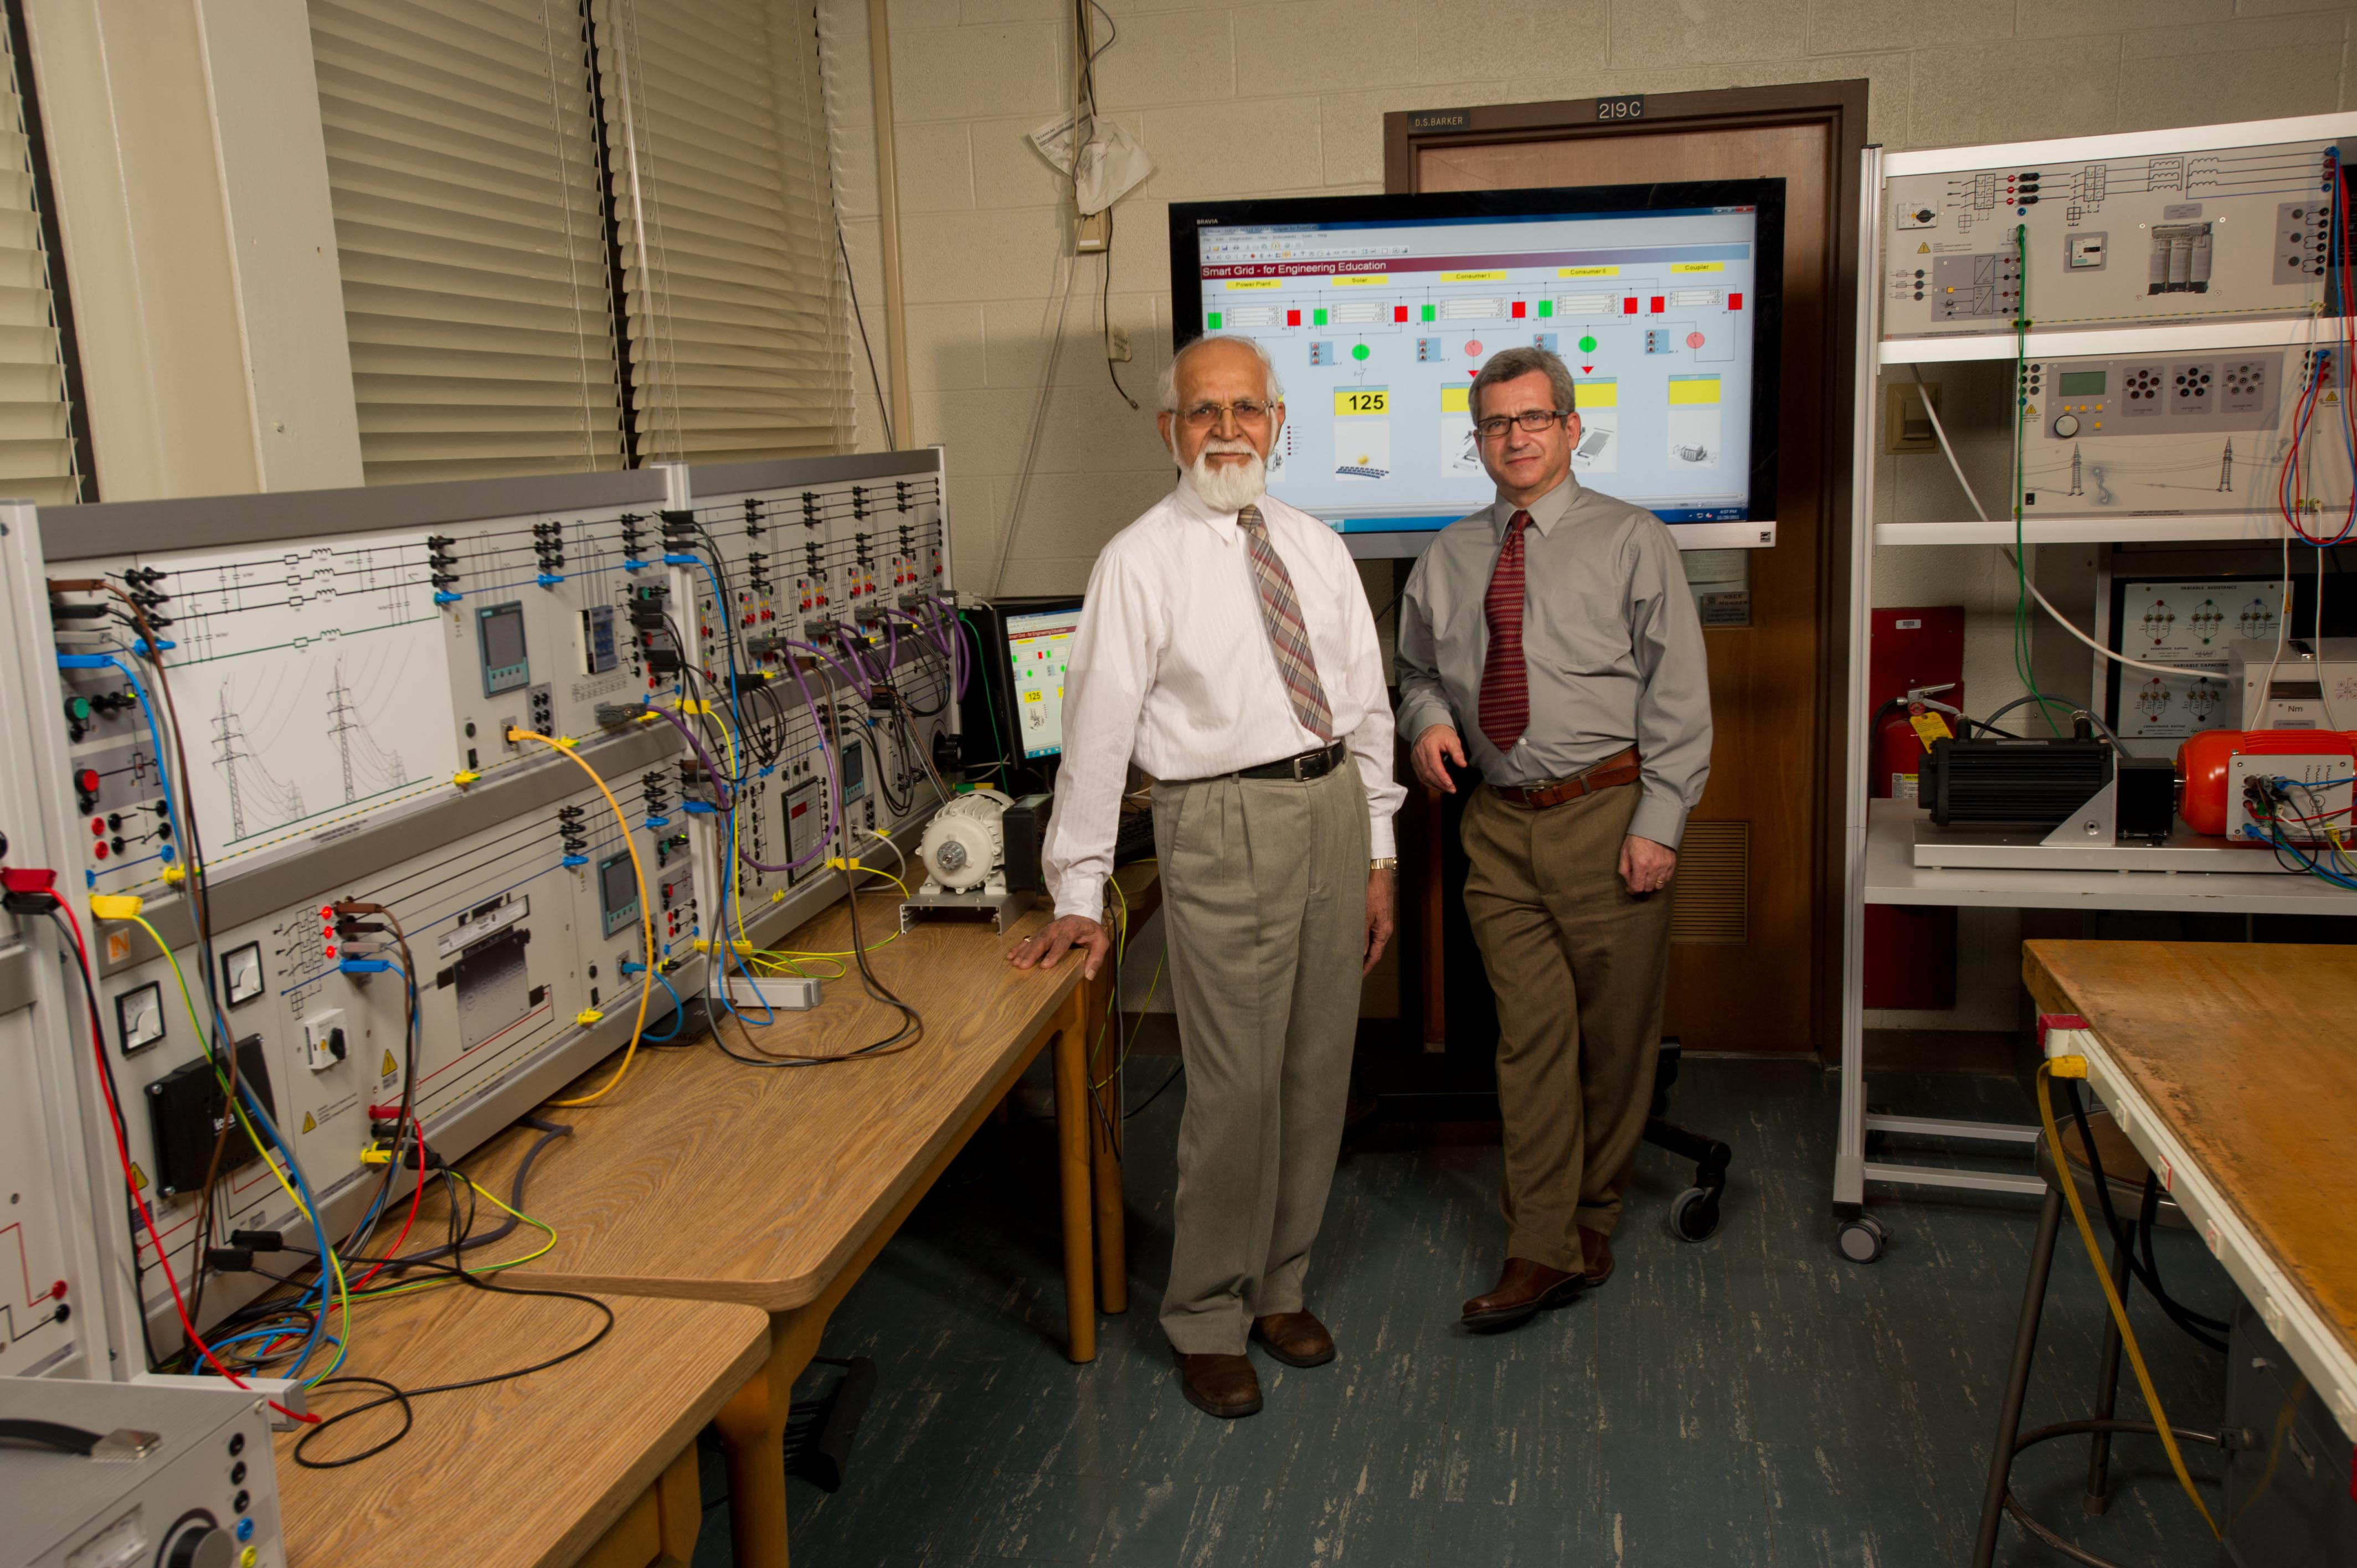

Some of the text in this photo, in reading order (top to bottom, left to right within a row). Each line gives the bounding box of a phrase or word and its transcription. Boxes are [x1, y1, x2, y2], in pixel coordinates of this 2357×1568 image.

[1599, 101, 1641, 120] 219C
[1202, 266, 1231, 276] Smart
[1233, 266, 1254, 275] Grid
[1263, 265, 1275, 274] for
[1278, 262, 1336, 275] Engineering
[1338, 261, 1386, 272] Education
[1349, 395, 1385, 410] 125
[1028, 692, 1041, 701] 125
